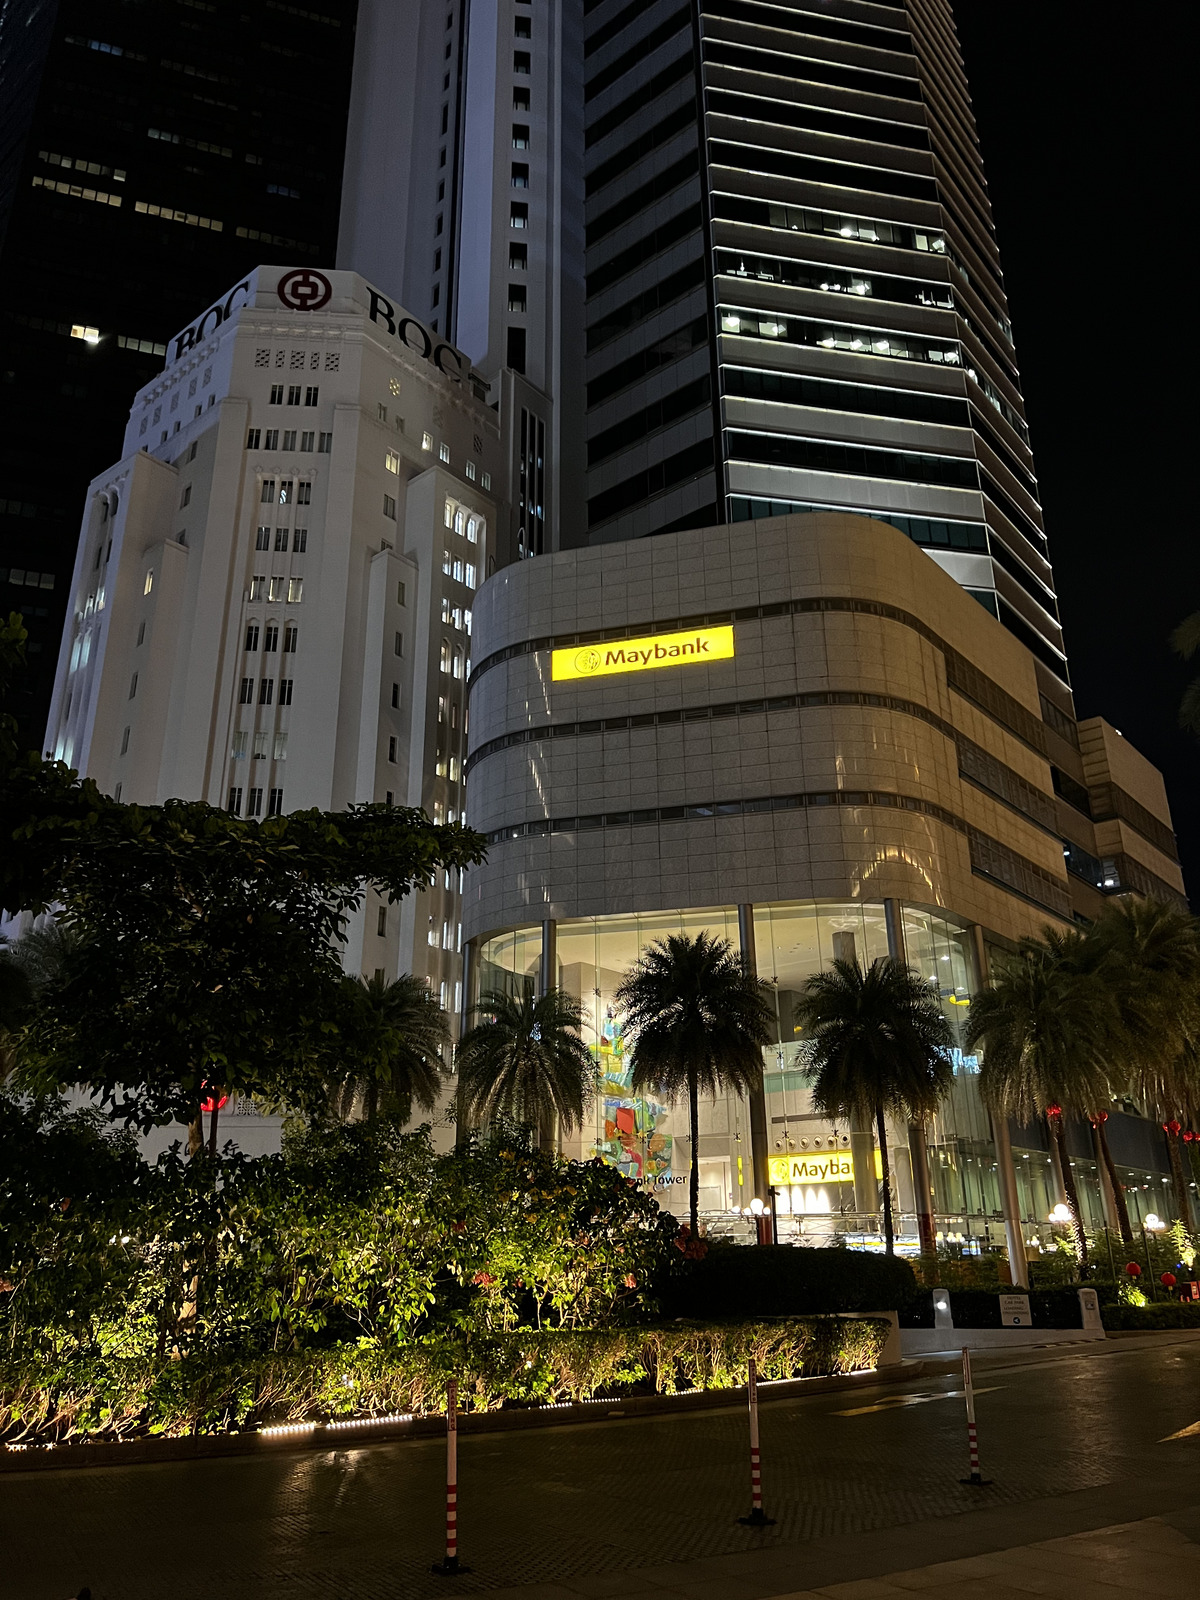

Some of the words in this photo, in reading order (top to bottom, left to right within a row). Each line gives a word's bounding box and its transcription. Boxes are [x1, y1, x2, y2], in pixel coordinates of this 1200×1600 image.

[175, 281, 249, 359] BOC
[366, 286, 462, 383] BOC
[605, 638, 710, 666] Maybank
[653, 1175, 688, 1186] Tower
[793, 1159, 854, 1180] Mayba
